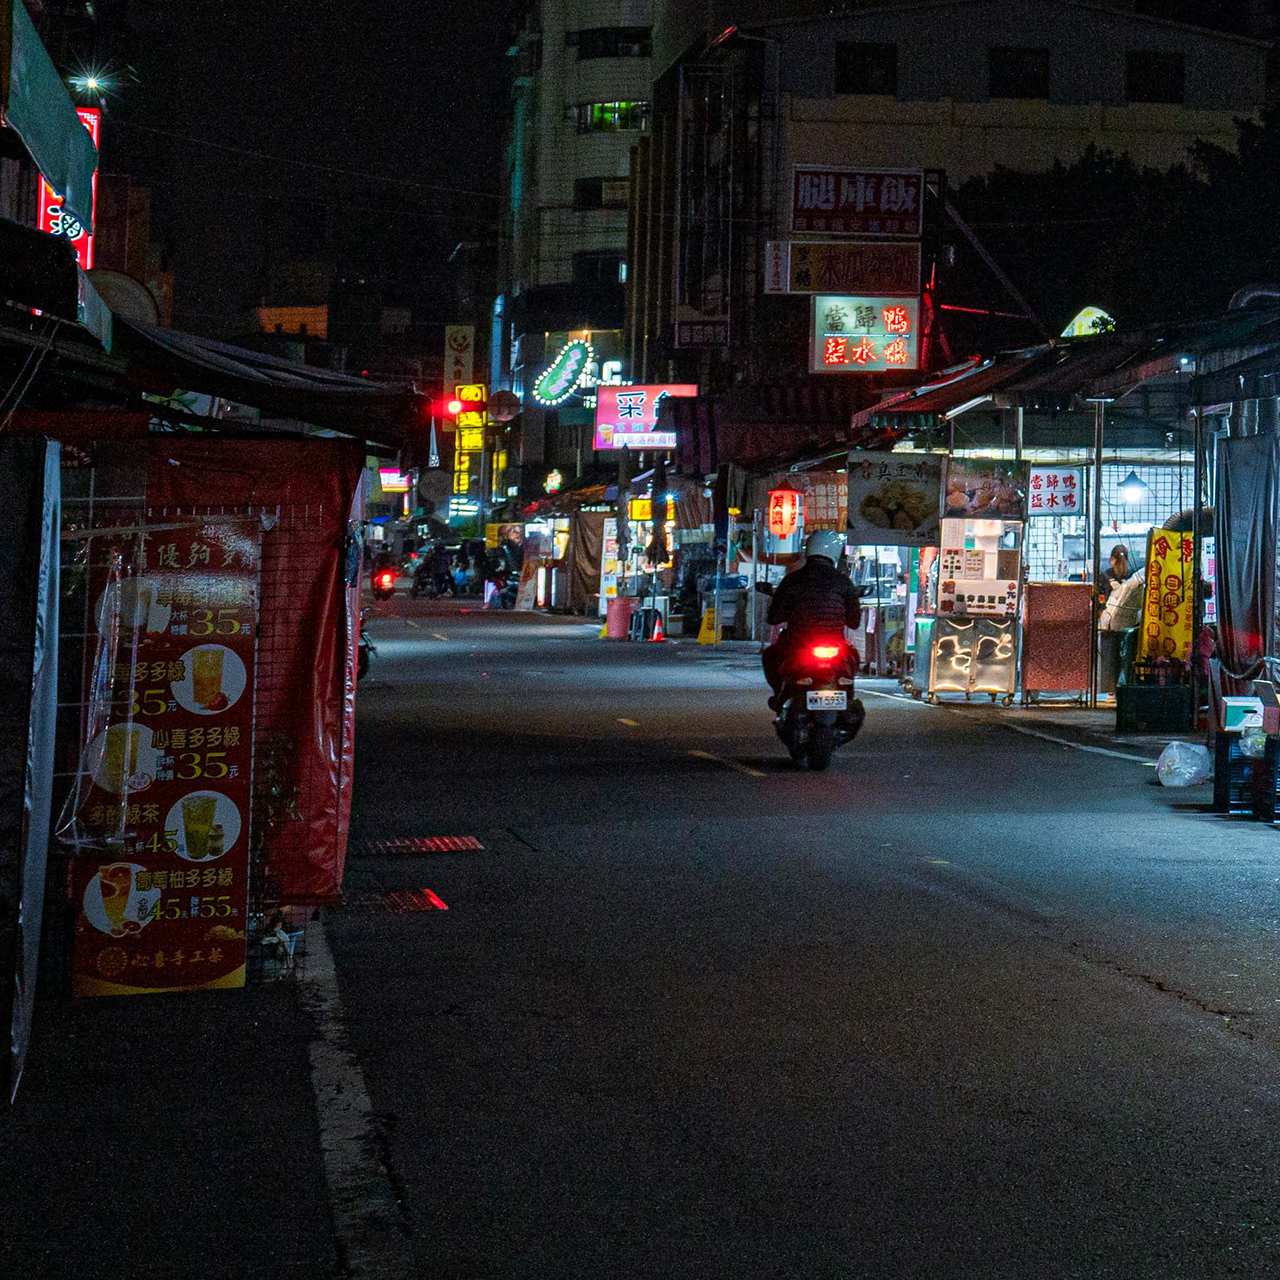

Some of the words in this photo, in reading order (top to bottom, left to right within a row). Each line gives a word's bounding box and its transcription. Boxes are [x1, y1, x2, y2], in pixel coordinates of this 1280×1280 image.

[799, 173, 918, 214] 腿庫飯
[824, 304, 909, 335] 當歸鴨
[1030, 474, 1077, 490] 當歸鴨
[189, 608, 241, 637] 35
[241, 624, 251, 636] 元
[167, 701, 178, 712] 元
[151, 726, 241, 750] 心喜多多綠
[176, 751, 229, 781] 35
[228, 765, 240, 779] 元
[145, 829, 179, 853] 45
[135, 867, 234, 892] 葡萄柚多多綠
[149, 897, 182, 921] 45
[200, 895, 232, 919] 55
